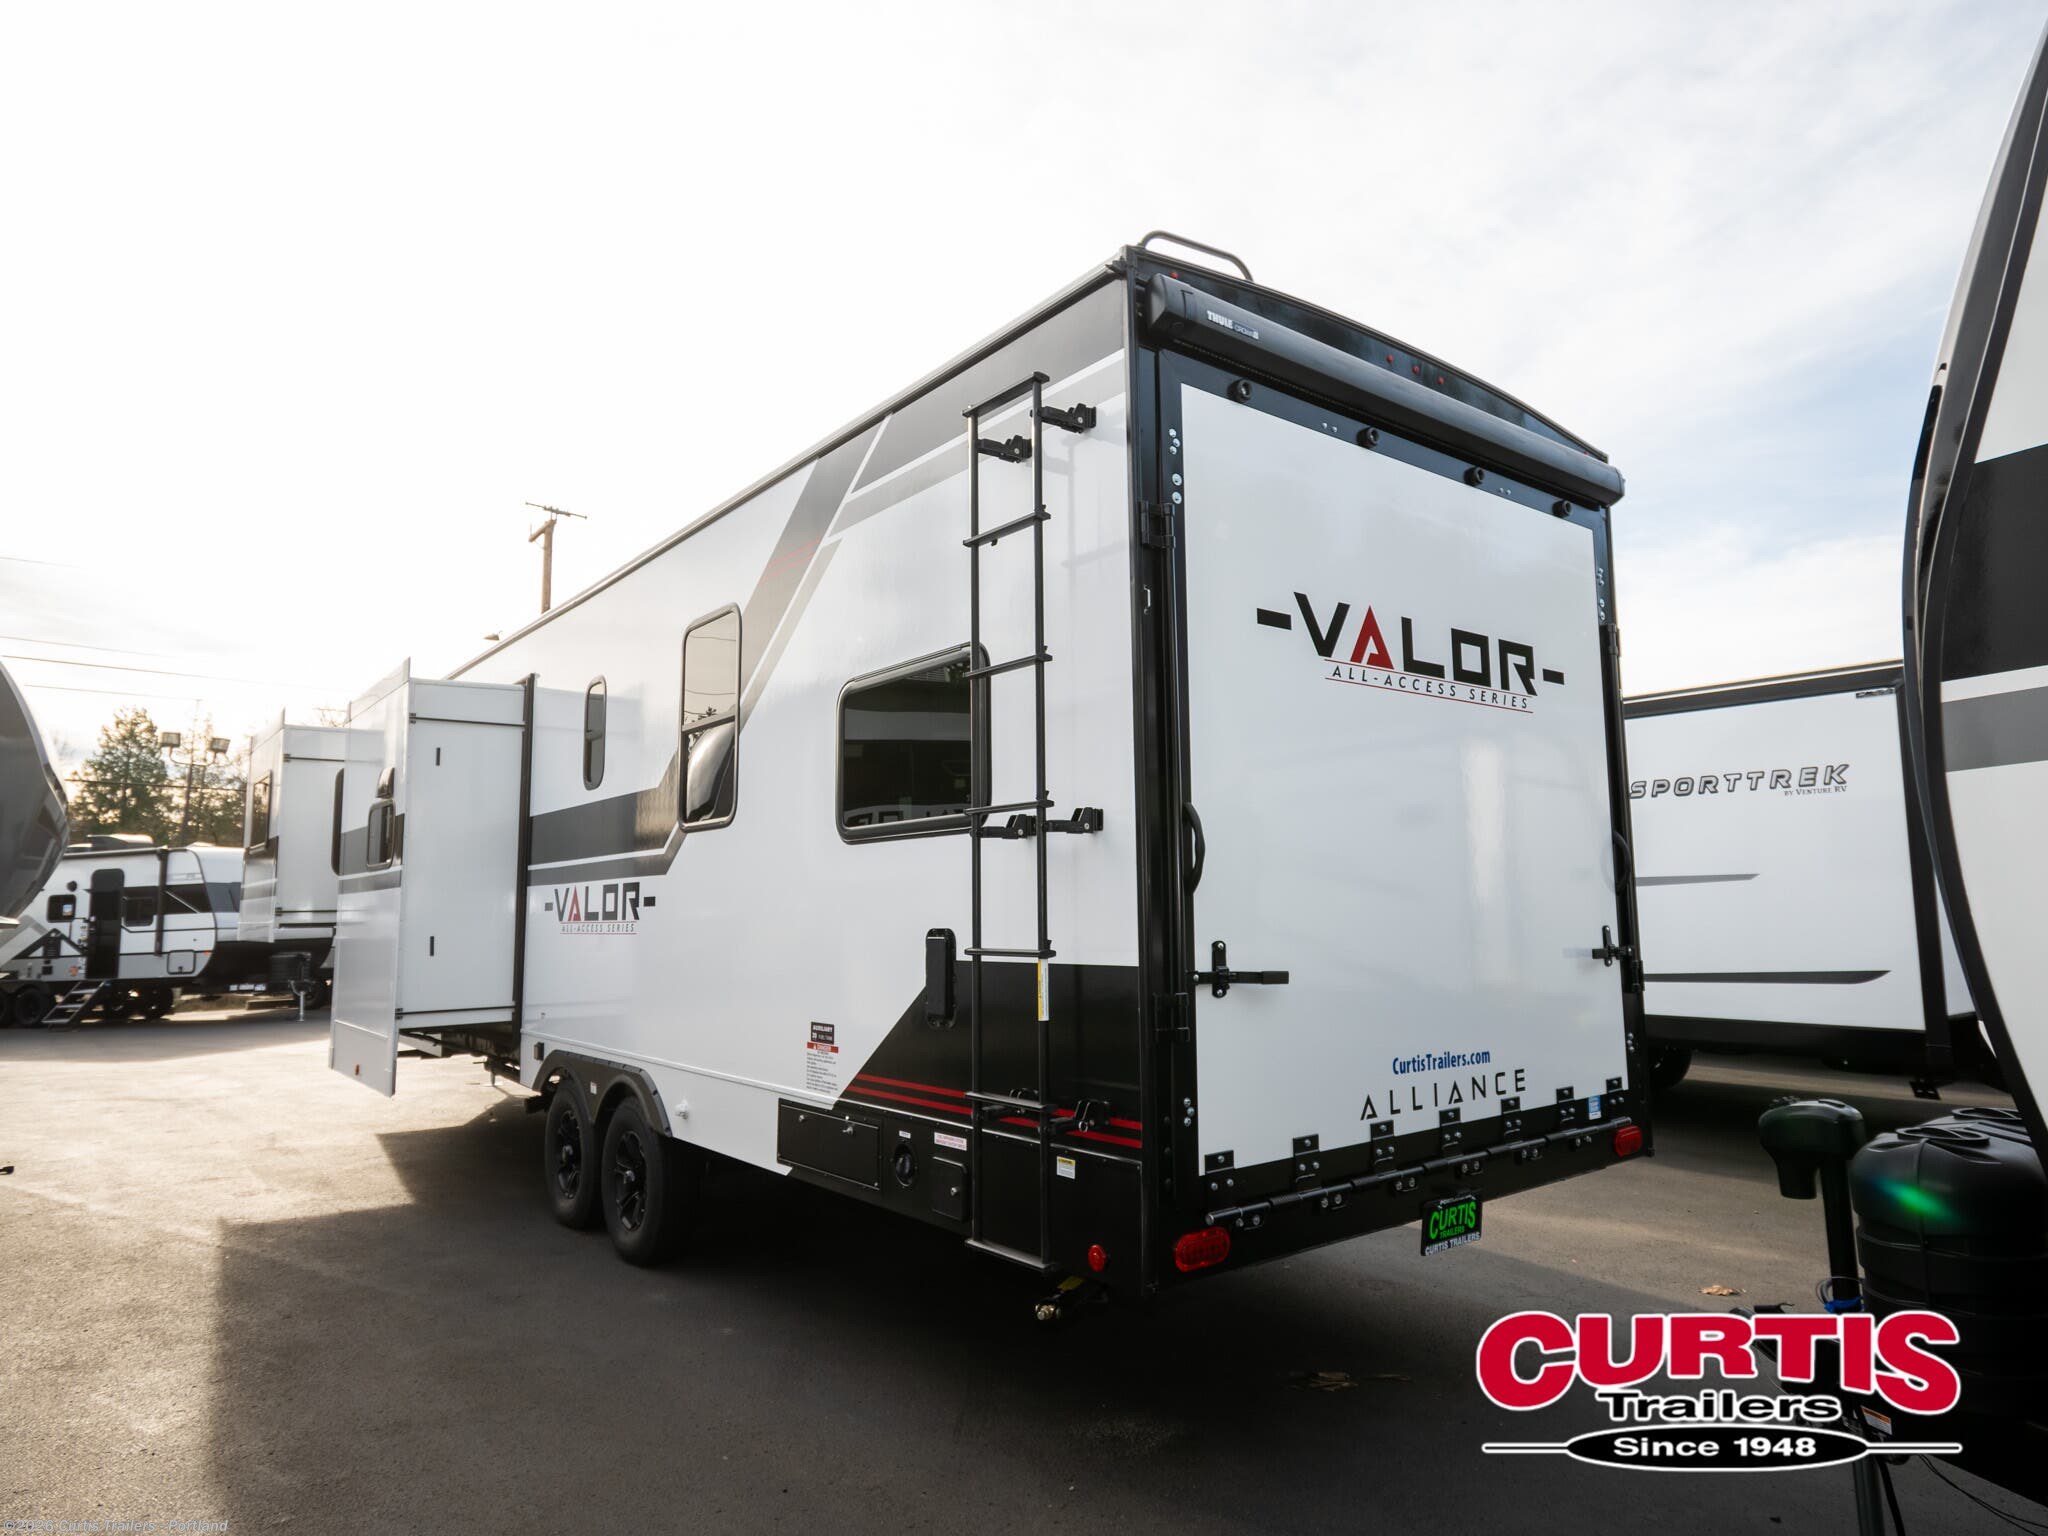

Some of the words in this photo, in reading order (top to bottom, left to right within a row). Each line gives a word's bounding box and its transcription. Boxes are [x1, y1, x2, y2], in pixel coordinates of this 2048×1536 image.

[1206, 310, 1233, 330] THULE
[1332, 665, 1456, 697] ALL-ACCESS
[1469, 688, 1528, 709] SERIES
[1629, 763, 1849, 799] SPORTTREK
[1834, 785, 1848, 794] RV
[562, 923, 603, 933] ALL-ACCESS
[607, 923, 635, 933] SERIES
[1392, 1050, 1491, 1075] CurtisTrailers.com
[1360, 1068, 1526, 1121] ALLIANCE
[1430, 1201, 1477, 1240] CURTIS
[1440, 1225, 1465, 1239] TRAILERS
[1425, 1240, 1449, 1256] CURTIS
[1449, 1231, 1481, 1248] TRAILERS
